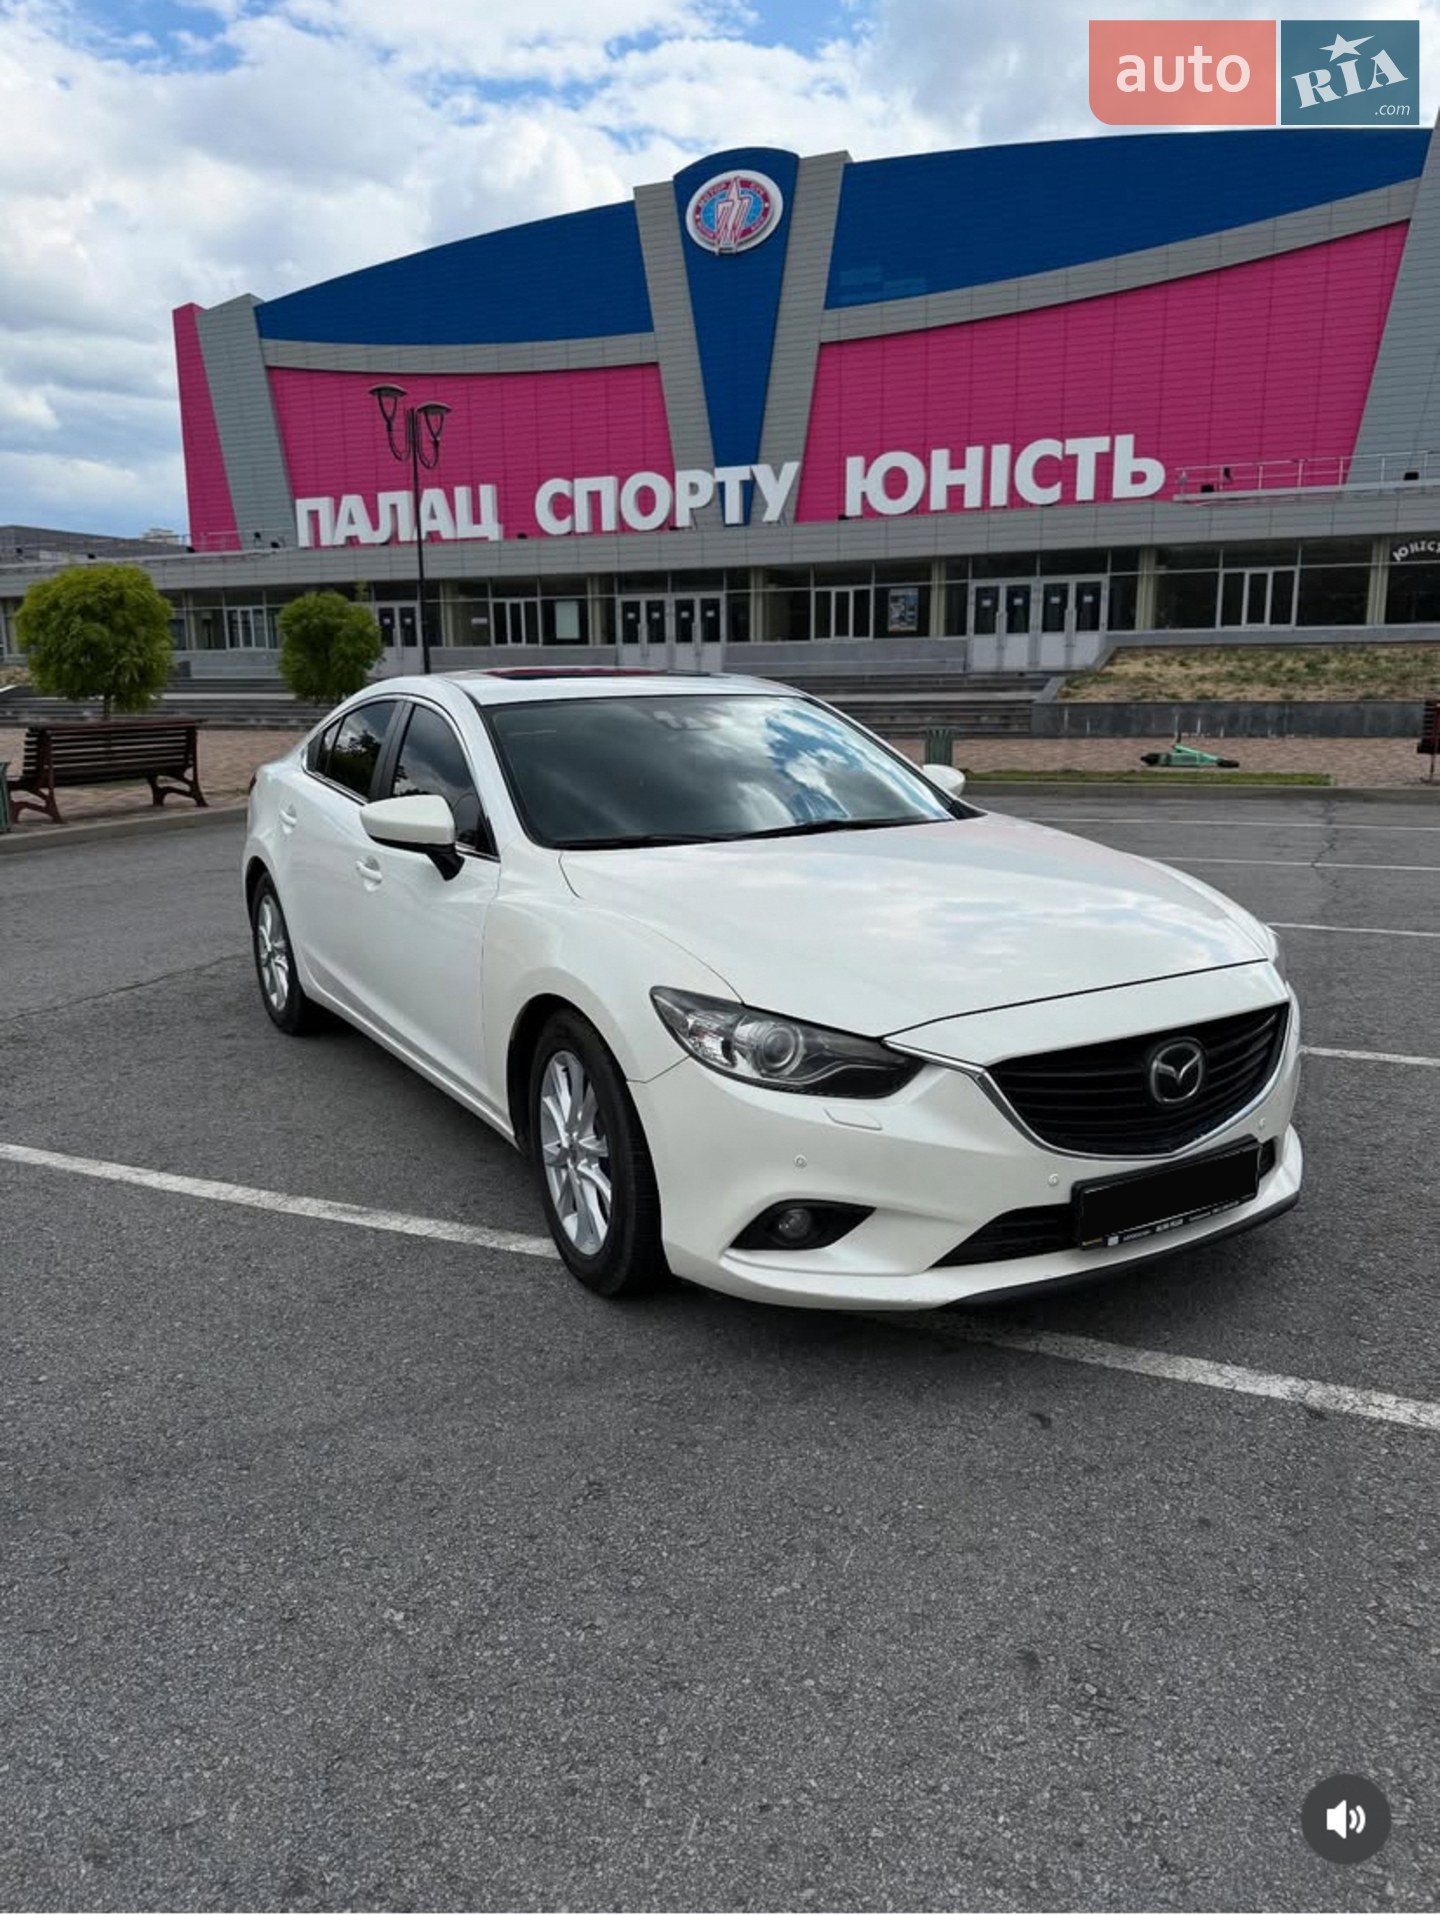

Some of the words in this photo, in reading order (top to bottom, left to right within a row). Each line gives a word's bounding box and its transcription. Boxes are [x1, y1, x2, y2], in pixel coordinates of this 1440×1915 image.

[295, 483, 503, 548] ПАЛАЦ
[534, 461, 800, 535] СПОРТУ
[845, 433, 1166, 517] ЮНІСТЬ
